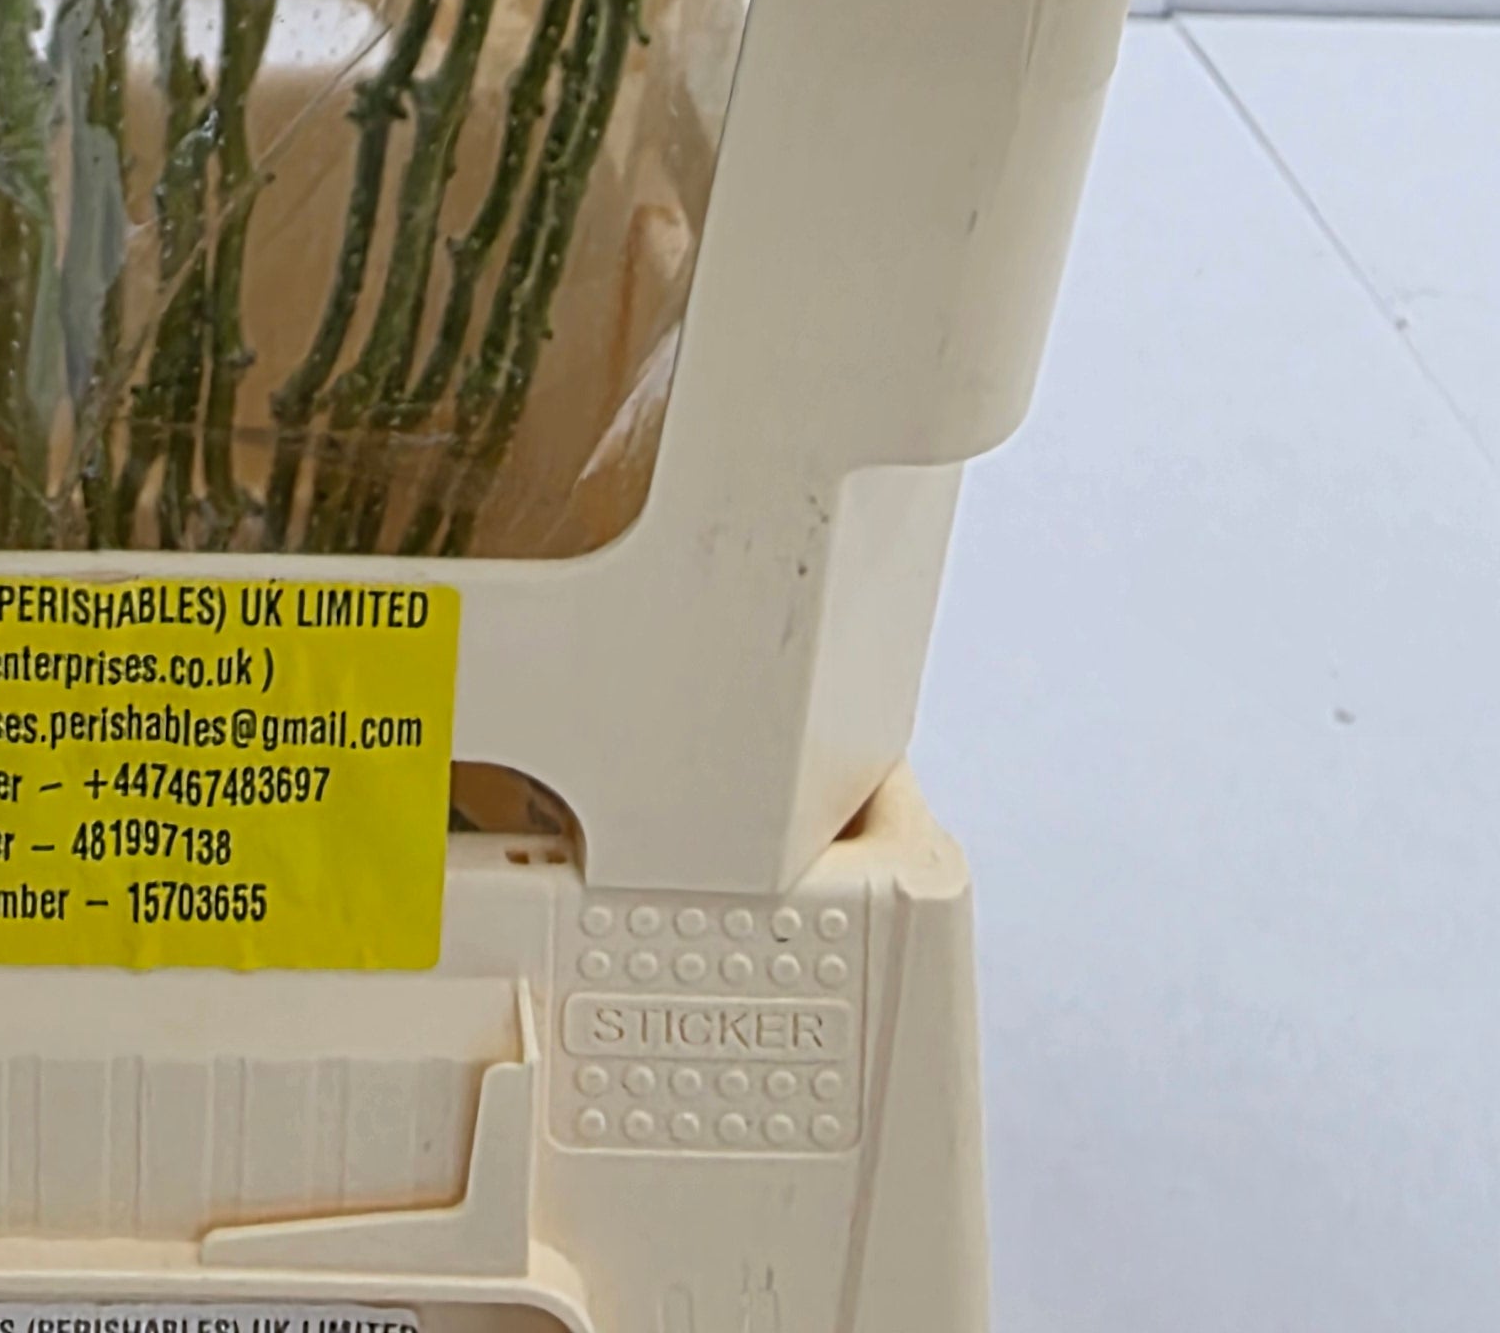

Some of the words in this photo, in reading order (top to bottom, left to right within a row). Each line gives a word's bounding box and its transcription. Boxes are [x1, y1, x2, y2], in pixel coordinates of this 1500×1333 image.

[241, 586, 284, 627] UK
[297, 588, 429, 629] LIMITED
[83, 762, 331, 807] +447467483697
[70, 820, 233, 866] 481997138
[127, 881, 268, 924] 15703655
[593, 1007, 824, 1049] STICKER
